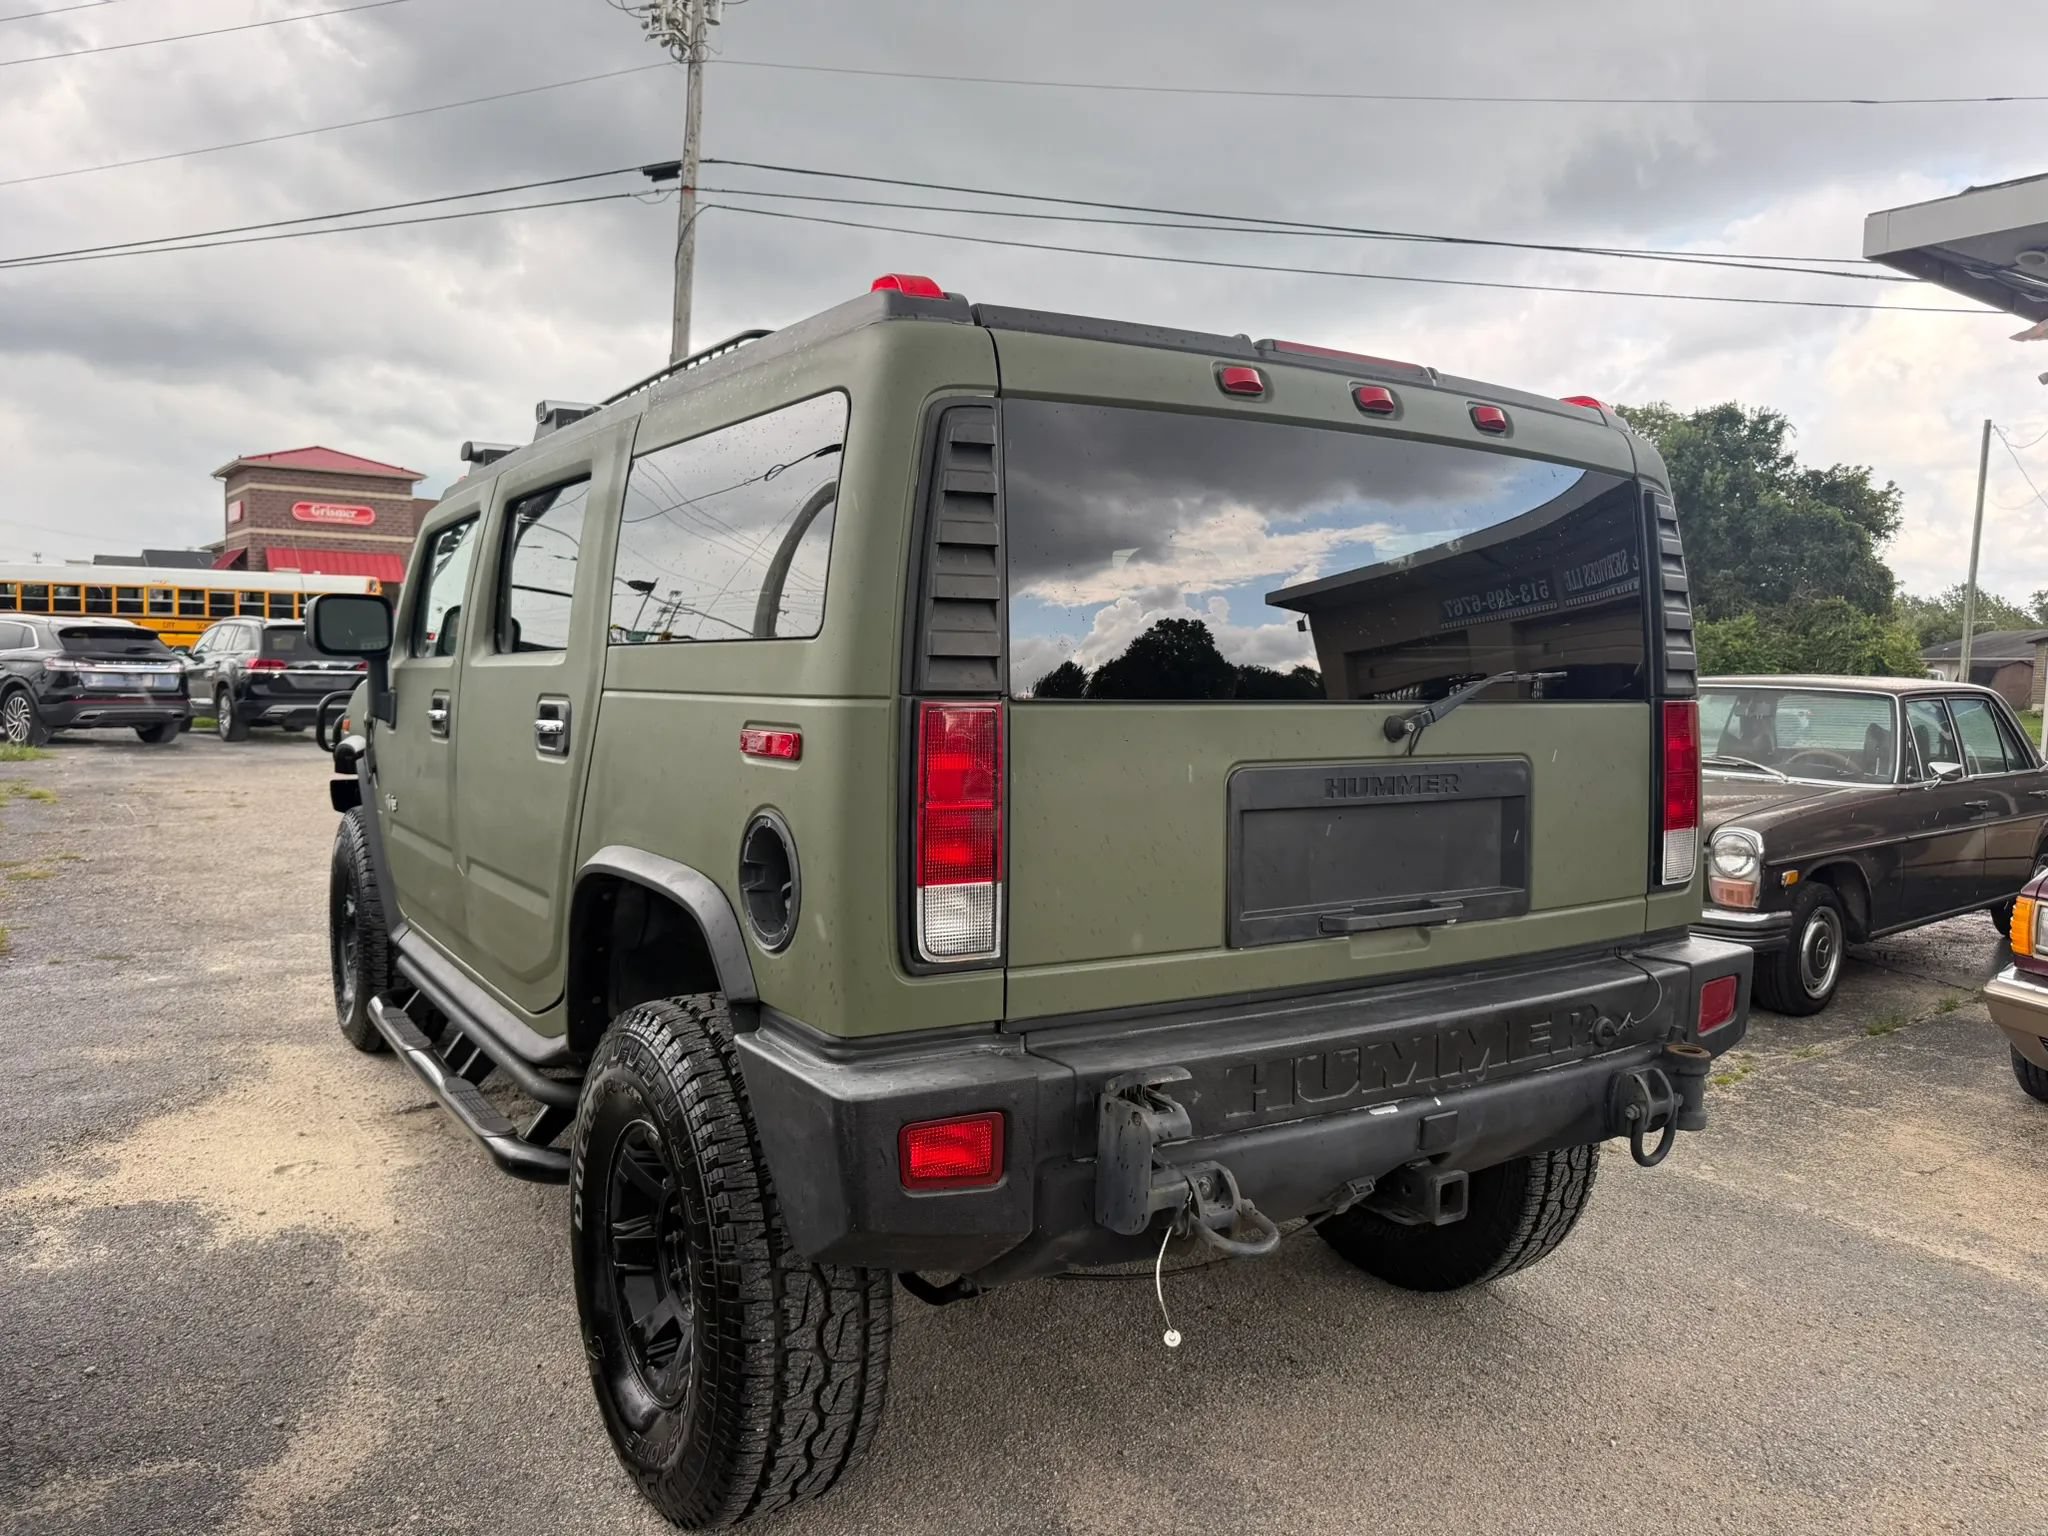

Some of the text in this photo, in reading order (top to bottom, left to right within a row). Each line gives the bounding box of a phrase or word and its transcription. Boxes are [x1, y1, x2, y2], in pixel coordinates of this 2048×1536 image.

[310, 503, 358, 519] Grismer
[1323, 773, 1461, 799] HUMMER
[1224, 1003, 1603, 1119] HUMMER
